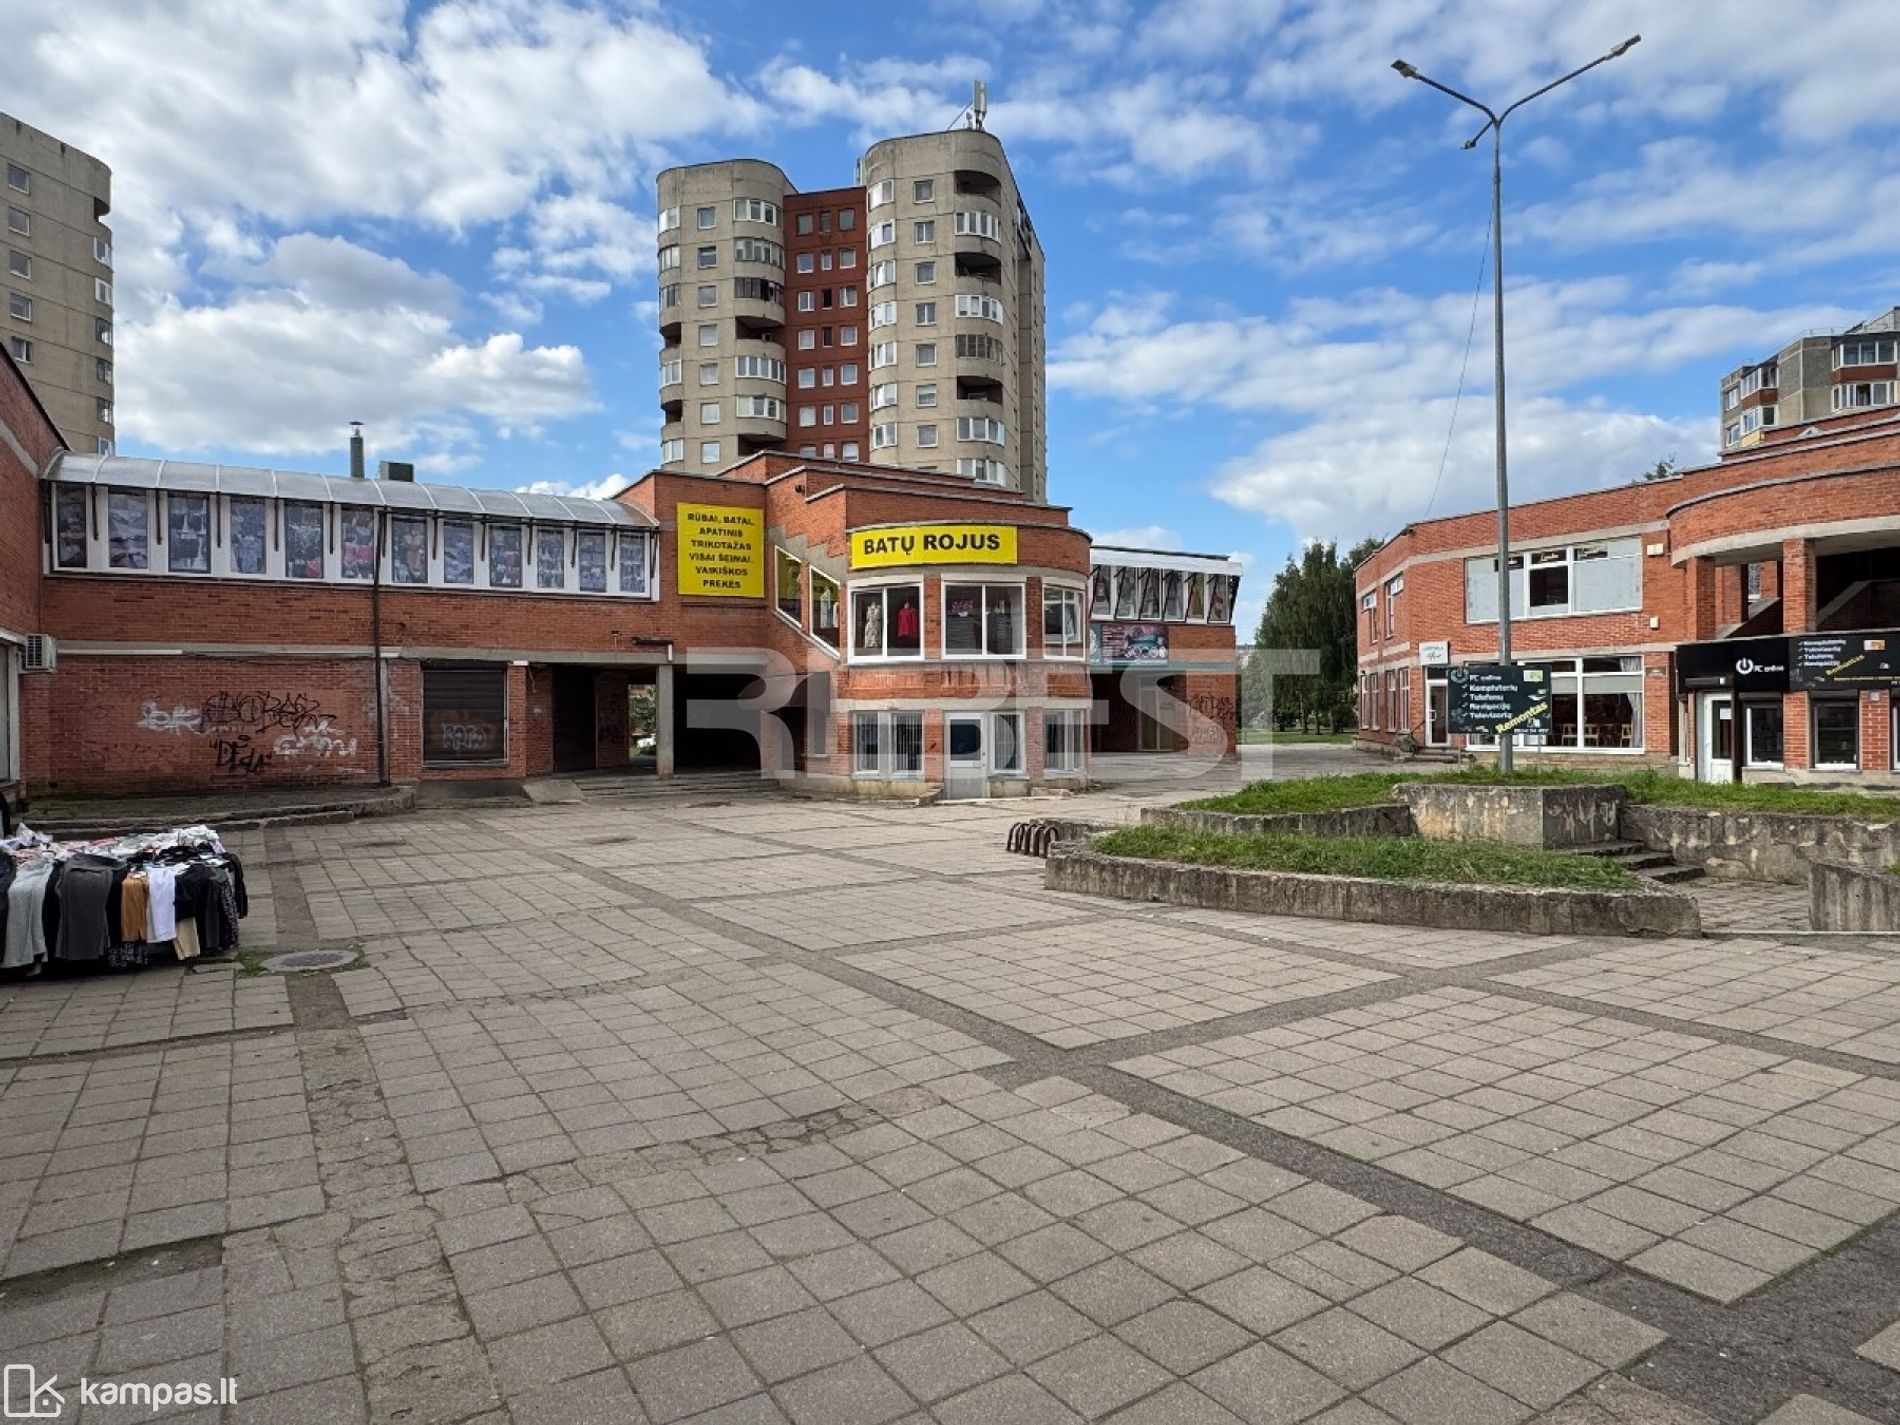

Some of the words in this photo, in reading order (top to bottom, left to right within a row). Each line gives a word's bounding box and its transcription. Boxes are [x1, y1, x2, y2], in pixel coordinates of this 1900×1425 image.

[699, 527, 743, 537] APATINIS
[691, 539, 751, 551] TRIKOTAŽAS
[864, 535, 915, 555] BATŲ
[923, 533, 1000, 550] ROJUS
[695, 564, 748, 576] VAIKIŠKOS
[703, 579, 741, 588] PREKĖS
[1495, 701, 1548, 733] Remontas
